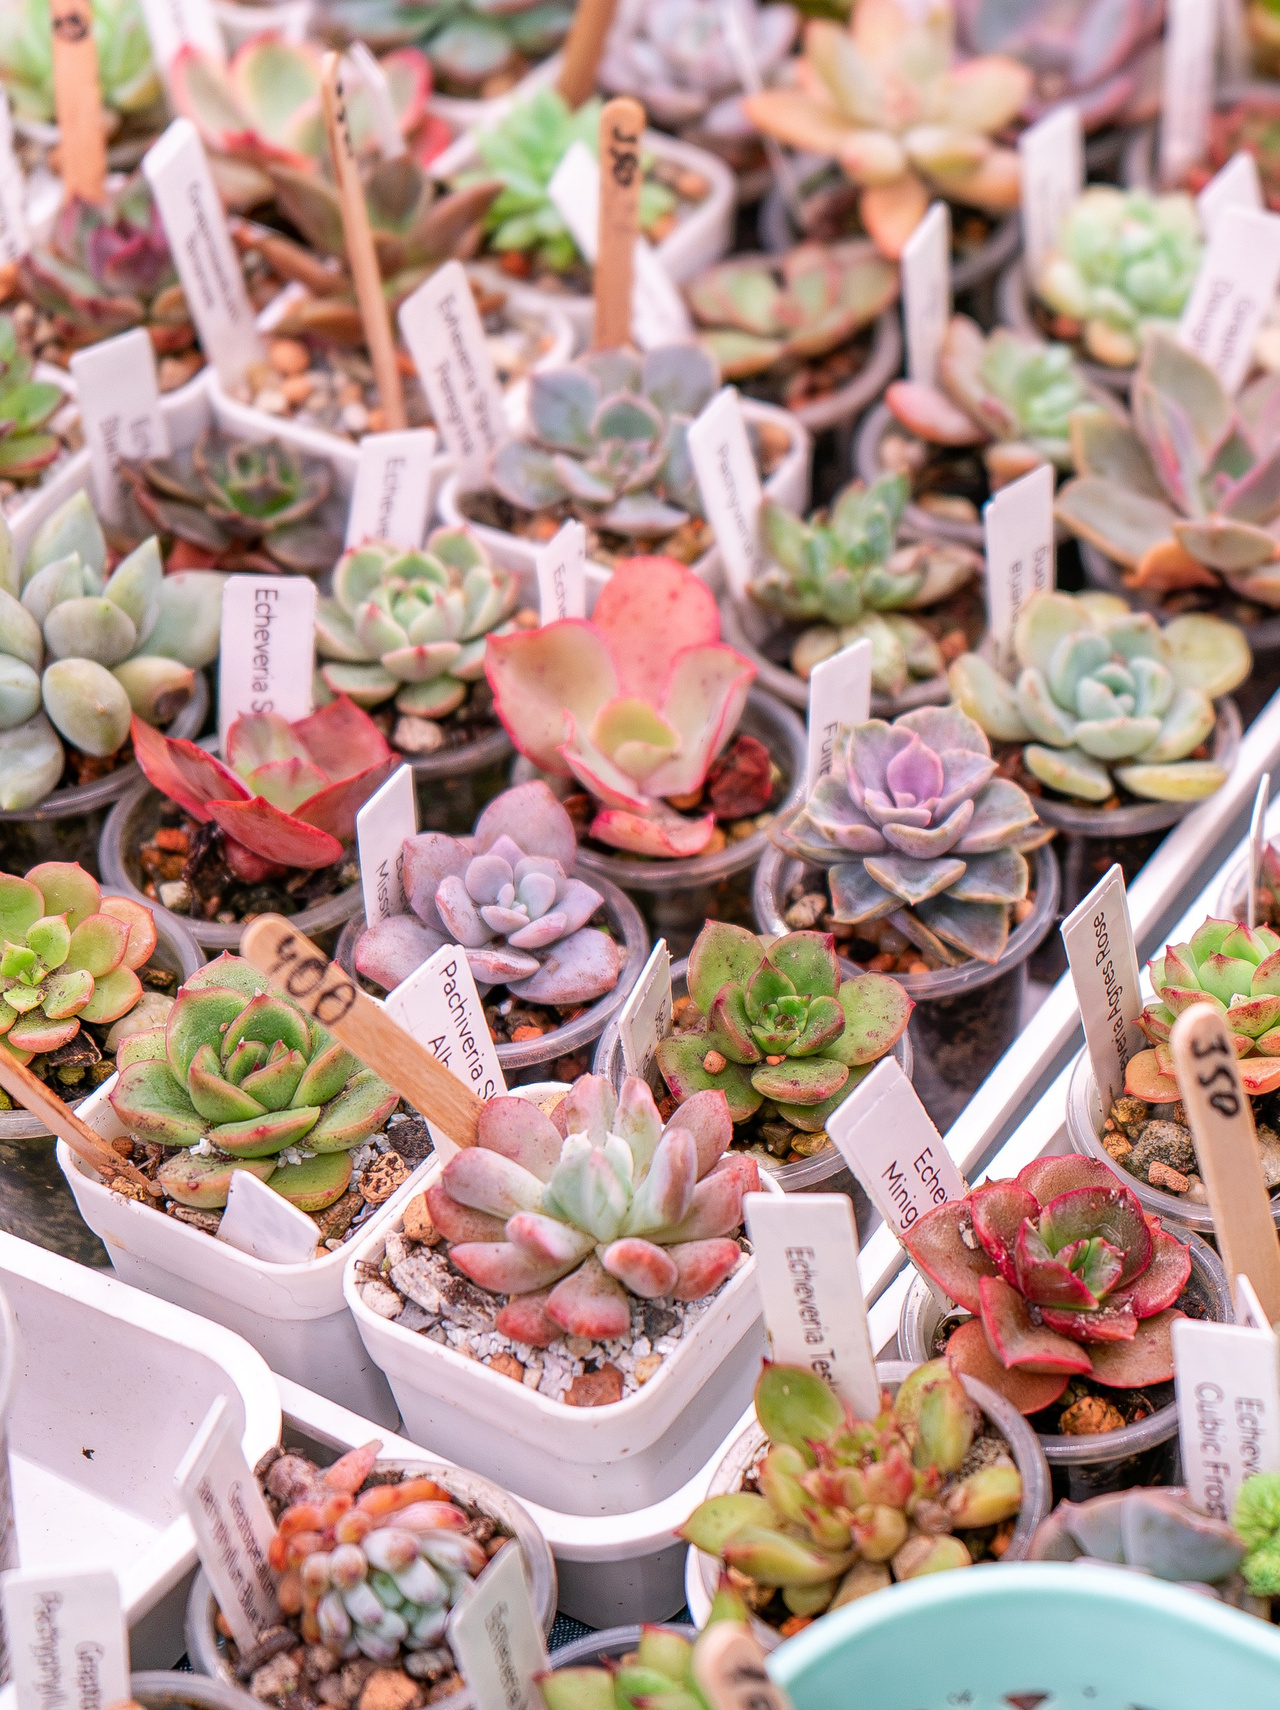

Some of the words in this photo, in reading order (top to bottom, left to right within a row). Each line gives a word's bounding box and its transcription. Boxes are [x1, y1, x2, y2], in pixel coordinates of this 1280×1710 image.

[252, 589, 279, 693] Echeveria
[270, 935, 357, 1026] 400
[1093, 912, 1110, 967] Rose
[440, 961, 487, 1081] Pachiveria
[478, 1079, 497, 1100] S
[1103, 960, 1123, 1021] Agnes
[1191, 1033, 1240, 1118] 350
[881, 1160, 919, 1229] Minig
[785, 1246, 827, 1345] Echeveria
[1194, 1382, 1227, 1455] Cubic
